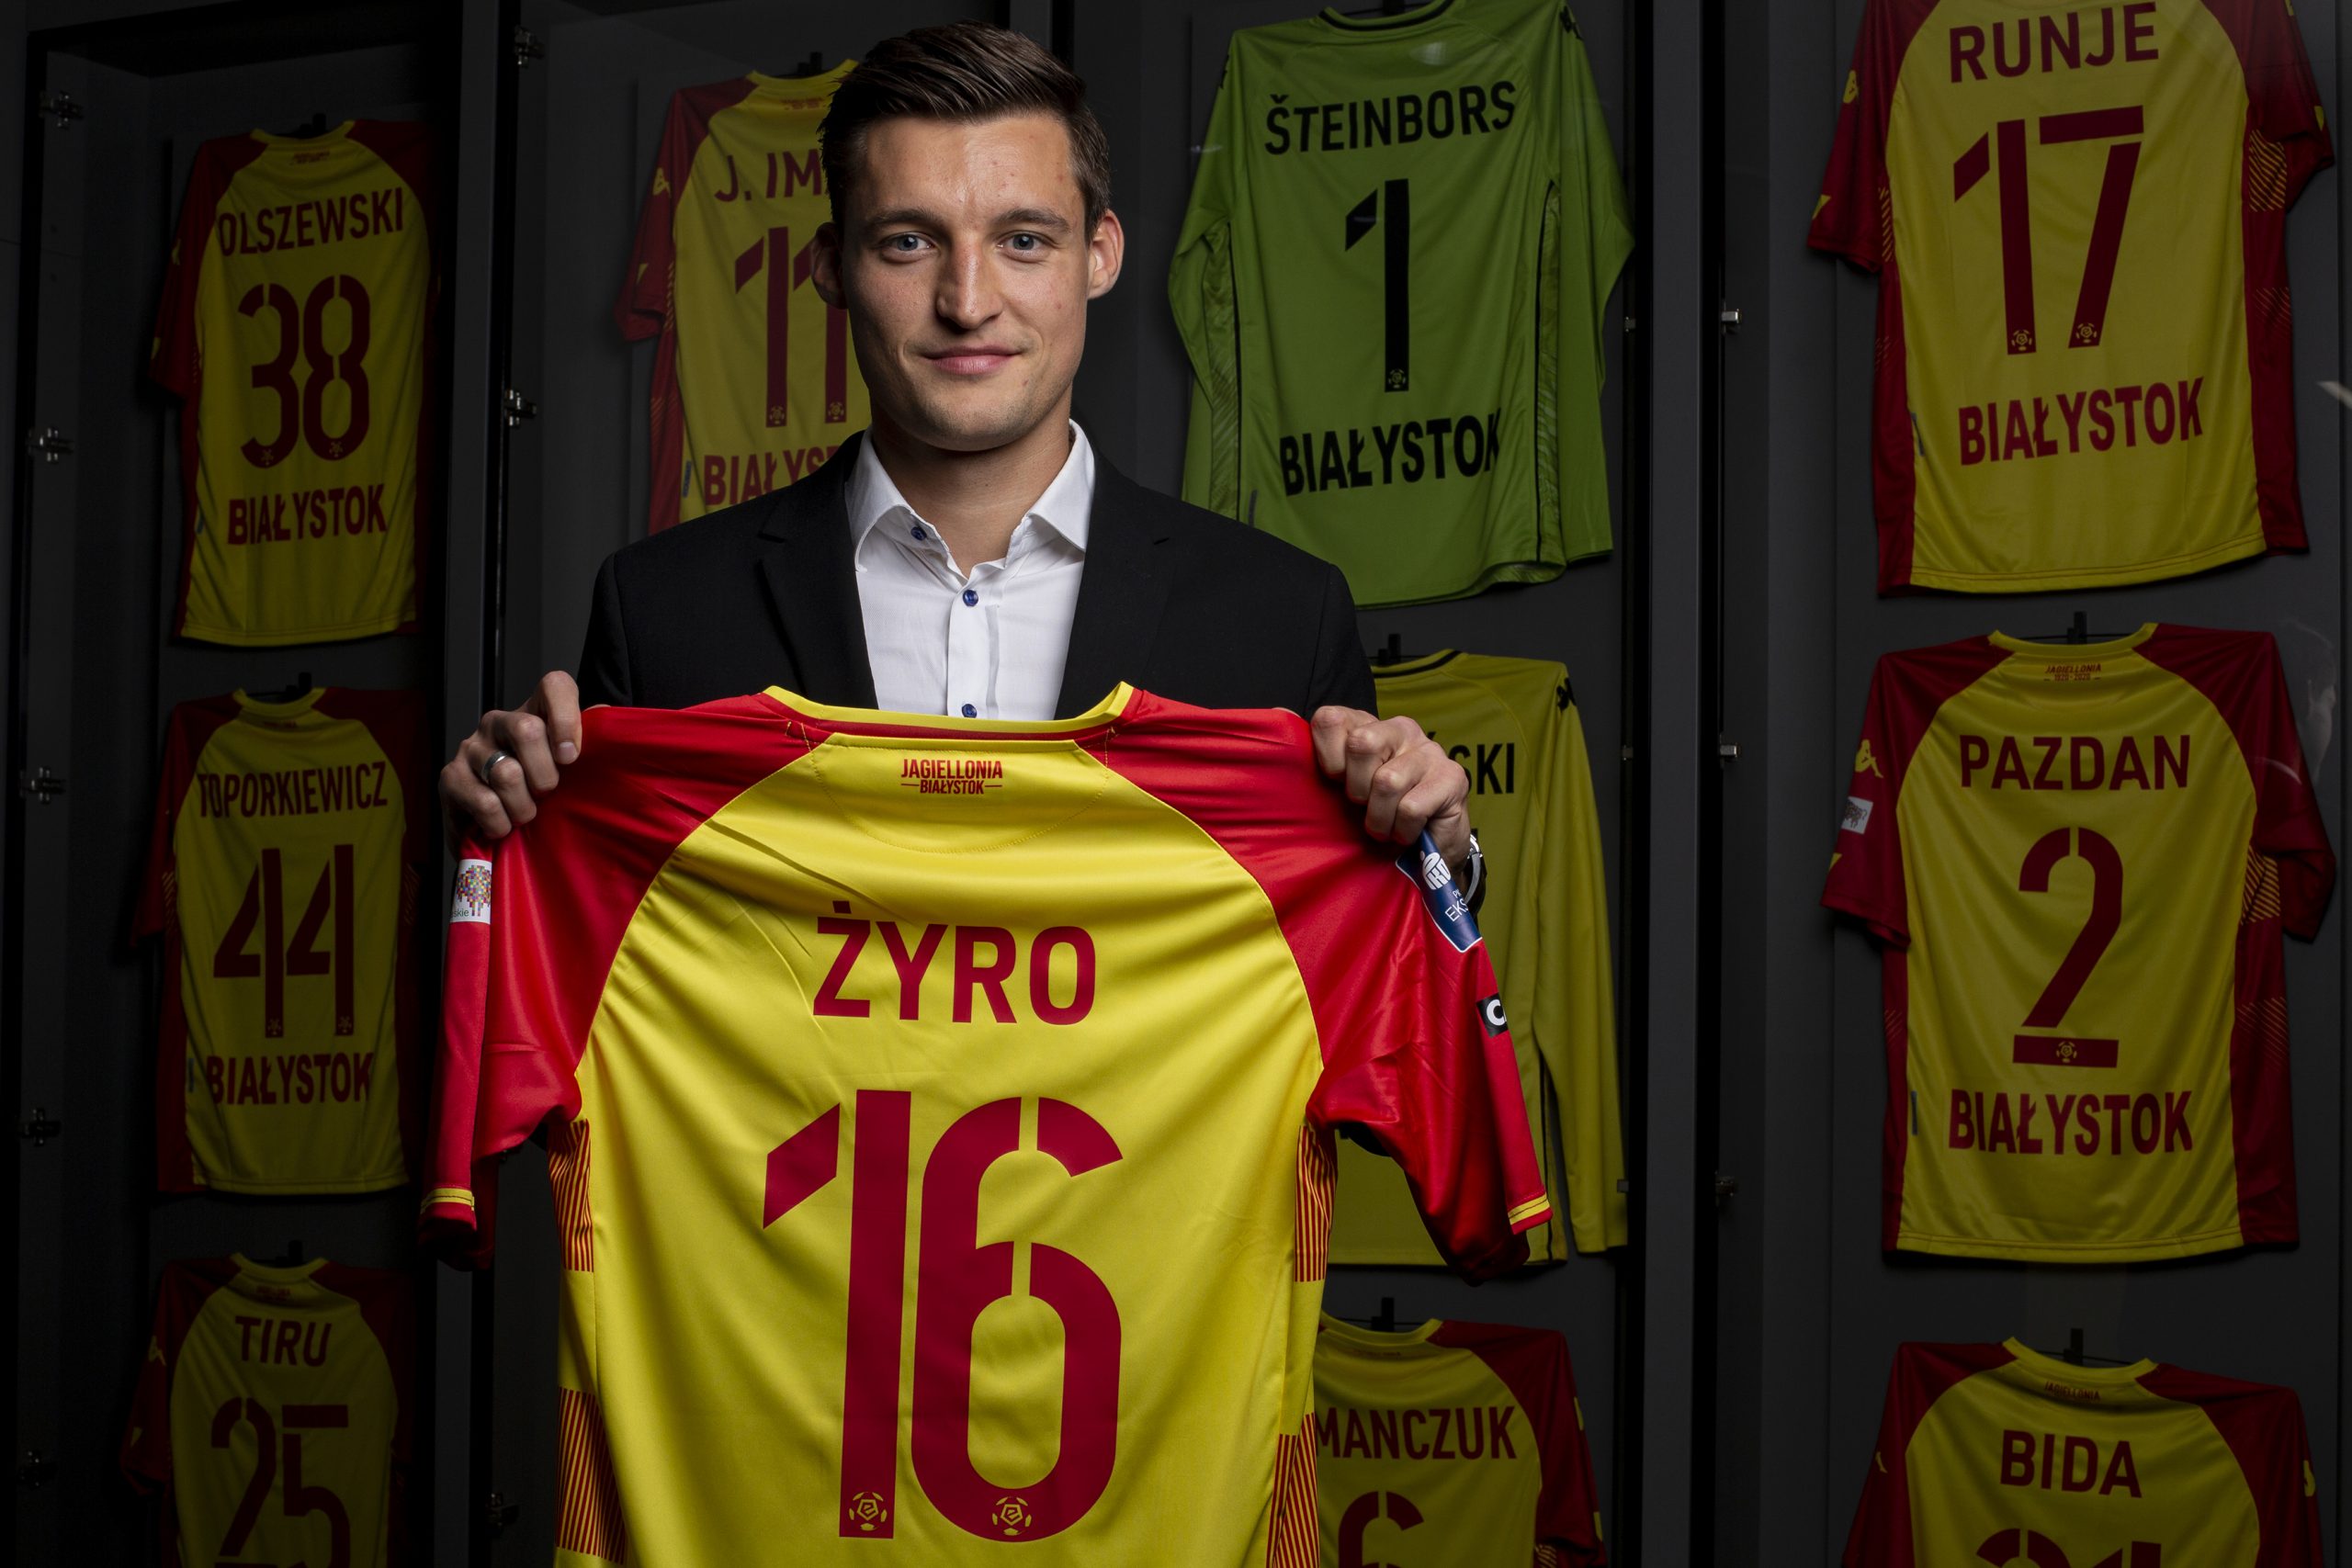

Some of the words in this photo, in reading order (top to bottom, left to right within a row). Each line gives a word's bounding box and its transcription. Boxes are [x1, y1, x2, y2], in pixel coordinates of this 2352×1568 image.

[1950, 3, 2159, 83] RUNJE
[1265, 81, 1516, 154] ŠTEINBORS
[714, 154, 752, 201] J.
[766, 149, 830, 198] IM
[219, 186, 404, 256] OLSZEWSKI
[1953, 106, 2143, 355] 17
[1345, 178, 1409, 391] 1
[735, 226, 848, 427] 11
[238, 275, 369, 468] 38
[1280, 408, 1502, 496] BIAŁYSTOK
[1958, 377, 2204, 466] BIAŁYSTOK
[704, 446, 840, 506] BIAŁYS
[227, 483, 387, 545] BIAŁYSTOK
[197, 761, 388, 818] TOPORKIEWICZ
[901, 759, 1002, 779] JAGIELLONIA
[920, 779, 984, 795] BIAŁYSTOK
[1959, 735, 2191, 791] PAZDAN
[213, 844, 355, 1038] 44
[813, 900, 1096, 1026] ŻYRO
[2013, 827, 2123, 1068] 2
[207, 1052, 374, 1106] BIAŁYSTOK
[1948, 1089, 2193, 1156] BIAŁYSTOK
[235, 1315, 332, 1367] TIRU
[763, 1089, 1123, 1543] 16
[211, 1397, 350, 1568] 25
[2000, 1429, 2143, 1498] BIDA
